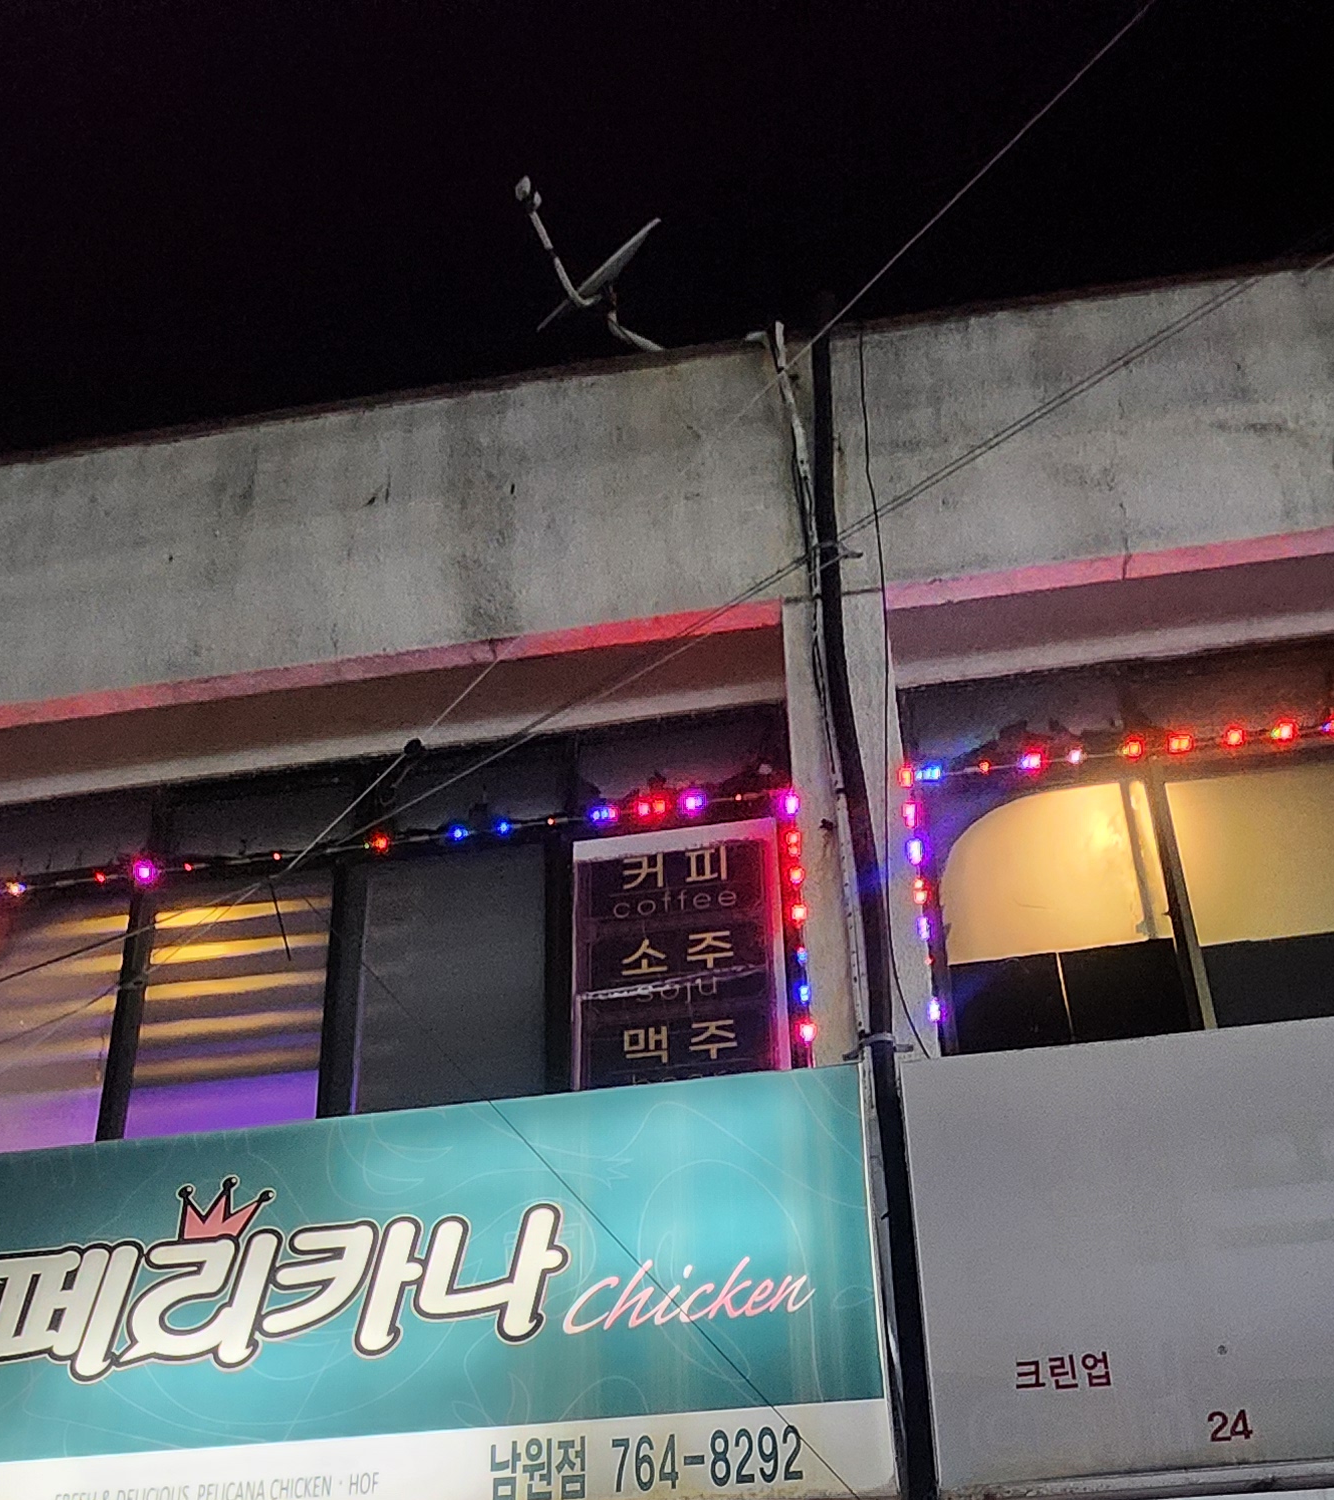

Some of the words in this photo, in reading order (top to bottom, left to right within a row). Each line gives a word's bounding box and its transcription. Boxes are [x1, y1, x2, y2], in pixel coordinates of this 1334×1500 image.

[622, 846, 728, 889] 커피
[613, 889, 738, 918] coffee
[621, 930, 734, 976] 소주
[622, 1019, 738, 1064] 맥주
[563, 1255, 817, 1338] Chicken
[1014, 1351, 1113, 1389] 크린업
[1206, 1409, 1254, 1442] 24
[610, 1424, 804, 1495] 764-8292
[348, 1471, 380, 1498] HOF
